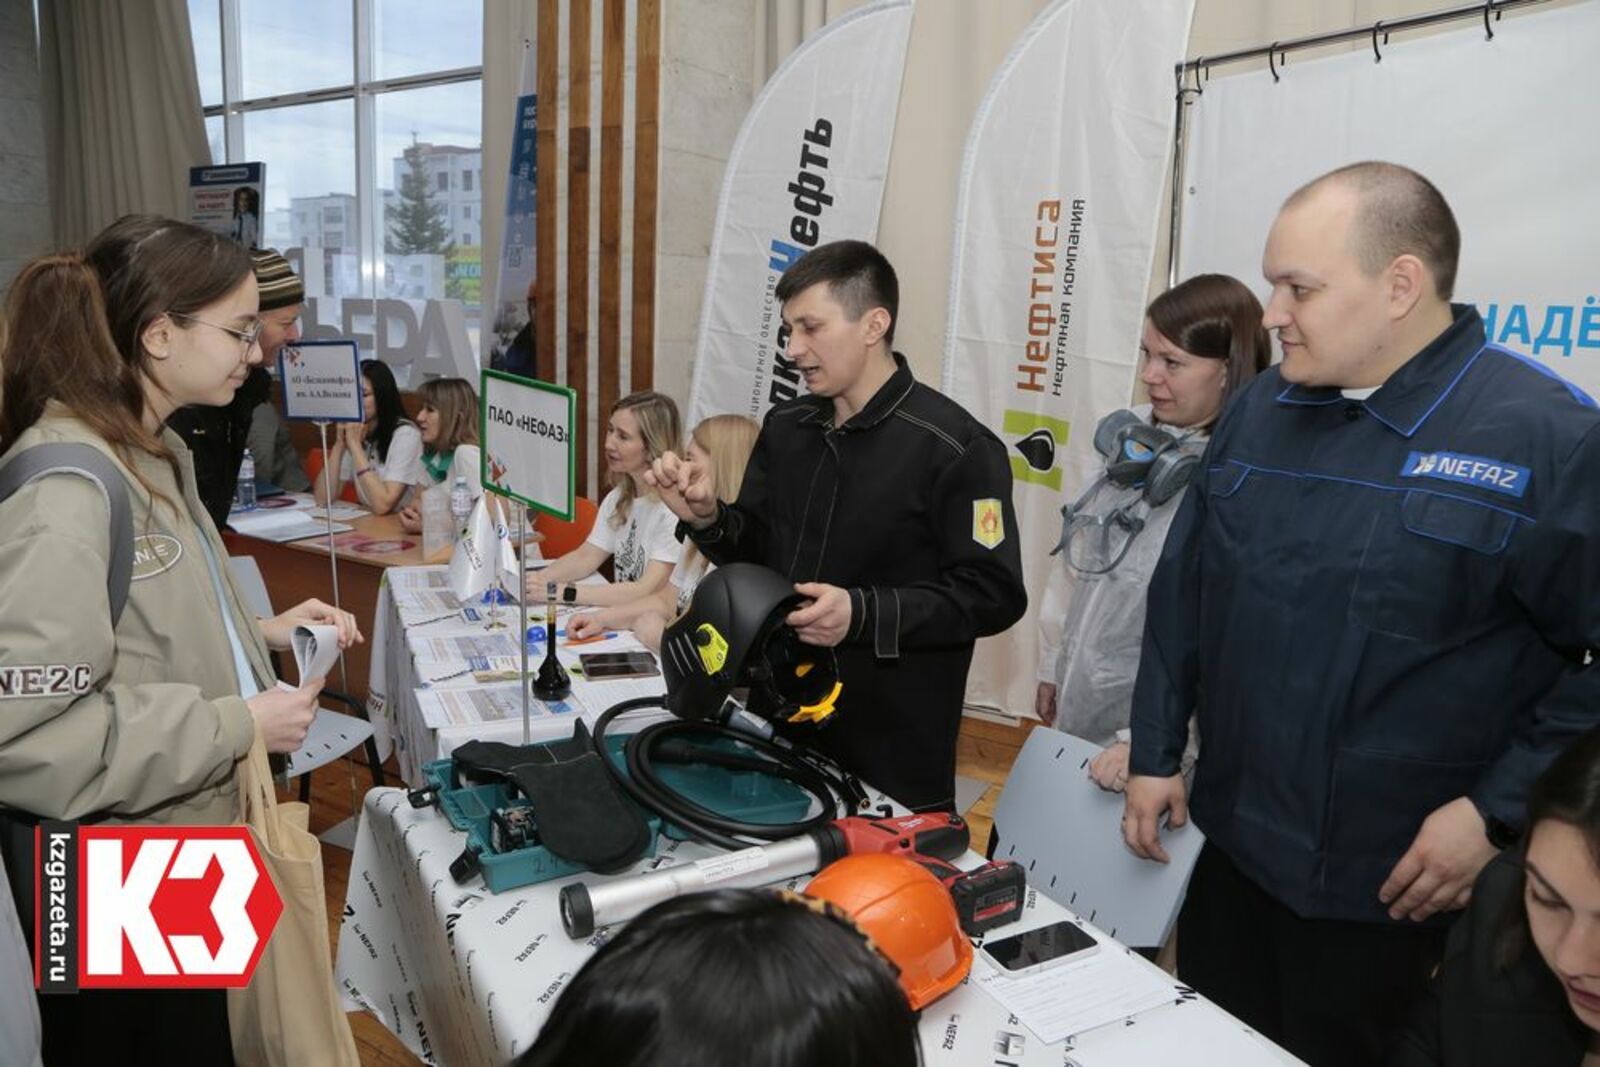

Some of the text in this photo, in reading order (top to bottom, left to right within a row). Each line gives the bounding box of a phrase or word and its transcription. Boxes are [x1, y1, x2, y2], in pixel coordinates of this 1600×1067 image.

[1016, 199, 1061, 393] Нефтиса
[488, 405, 514, 426] ПАО
[1437, 457, 1519, 489] NEFAZ
